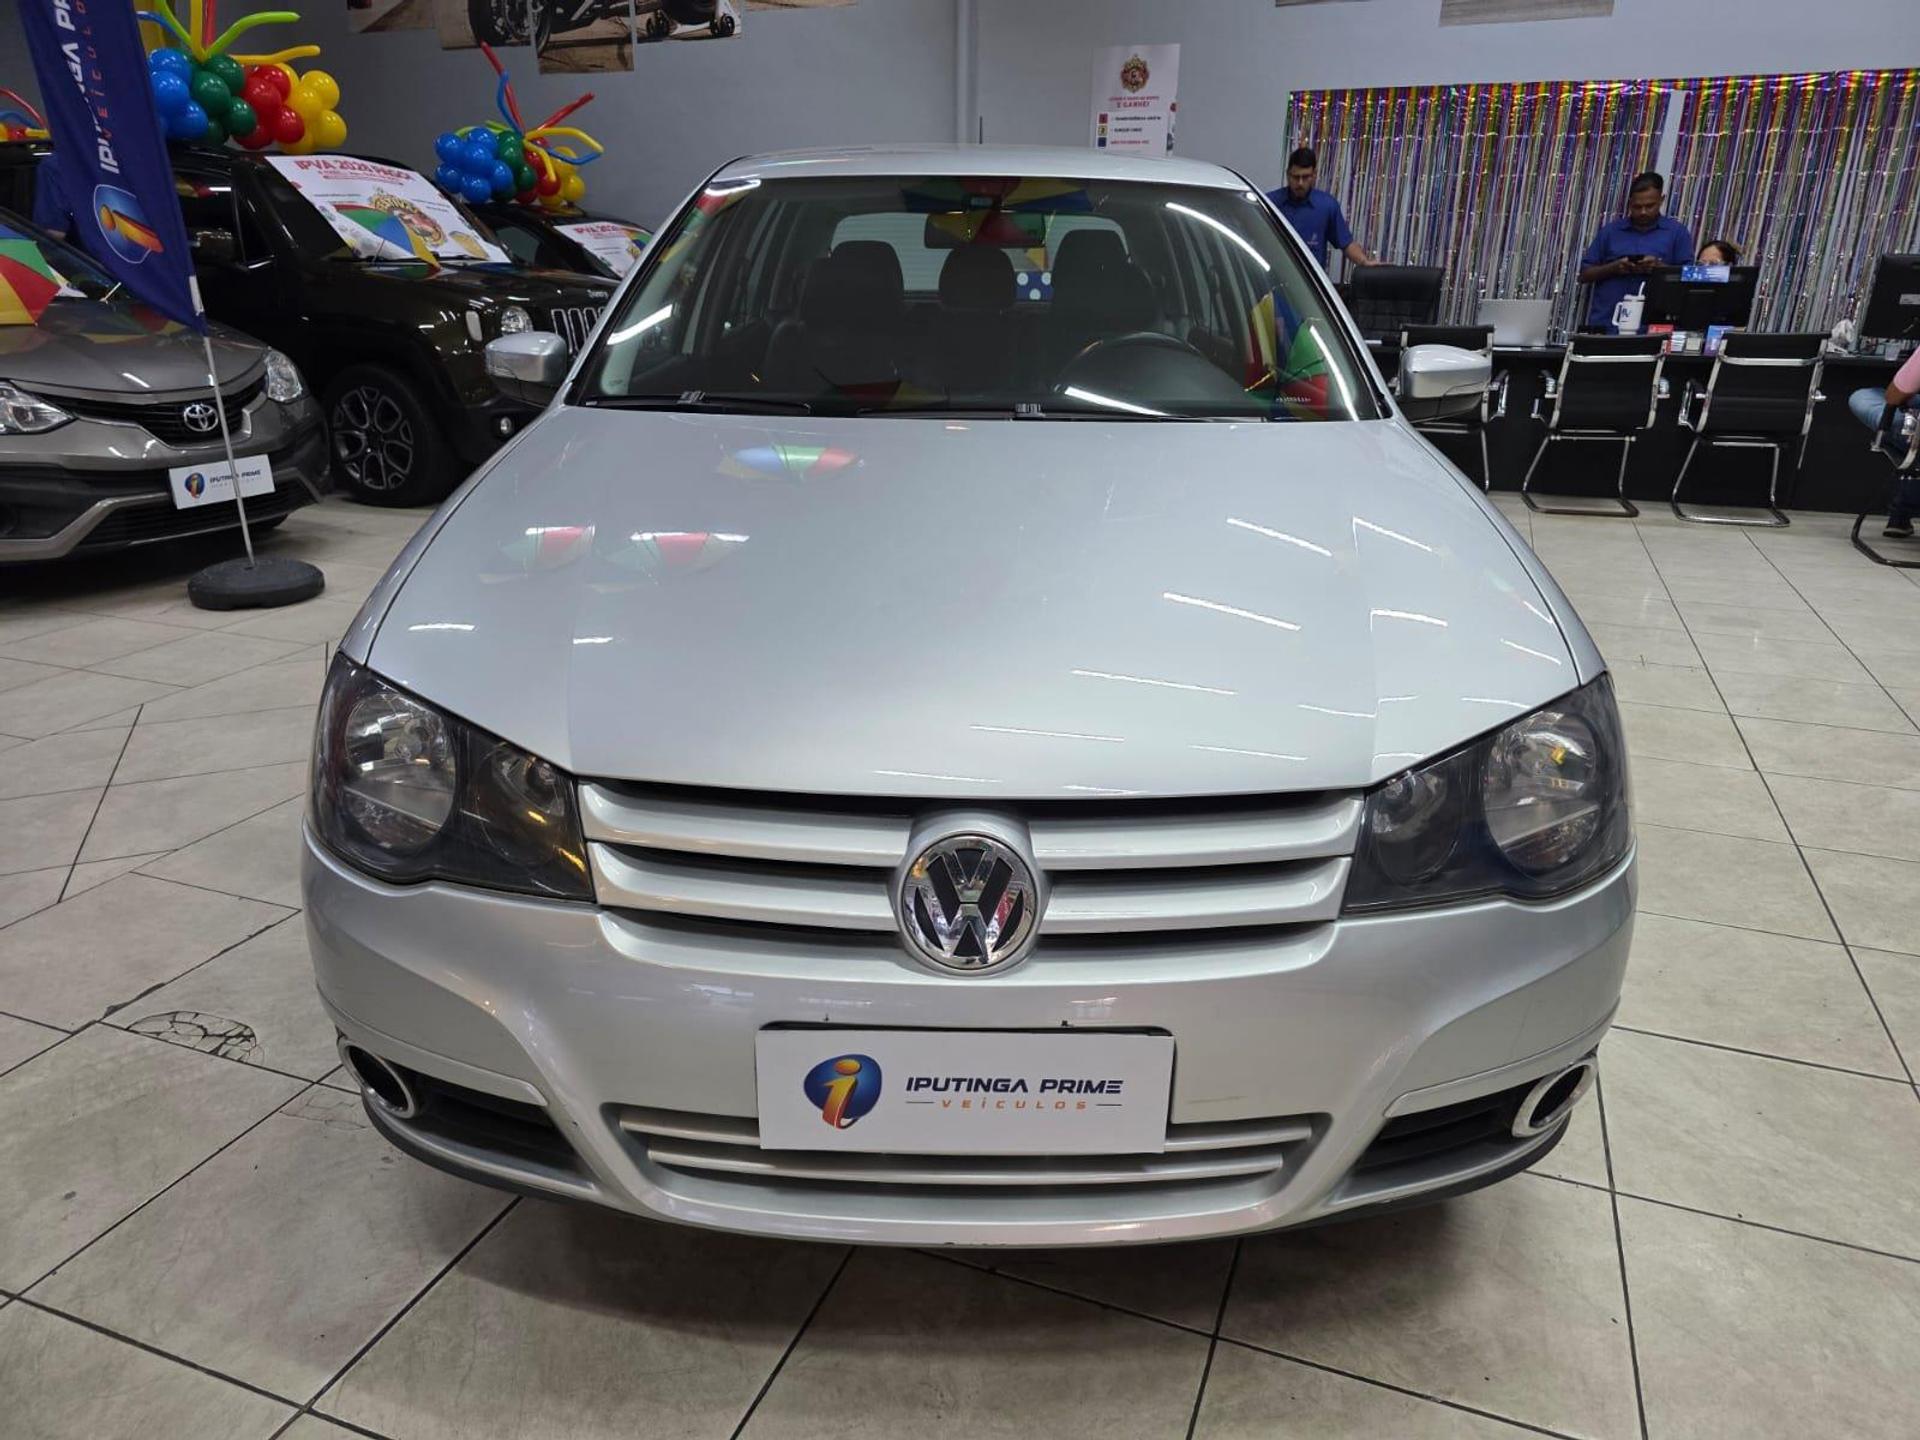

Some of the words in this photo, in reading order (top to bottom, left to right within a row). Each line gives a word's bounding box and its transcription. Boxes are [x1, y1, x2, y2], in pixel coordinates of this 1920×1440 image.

[905, 1077, 1029, 1093] IPUTINGA
[1039, 1079, 1124, 1094] PRIME
[941, 1097, 1087, 1110] VEÍCULOS
